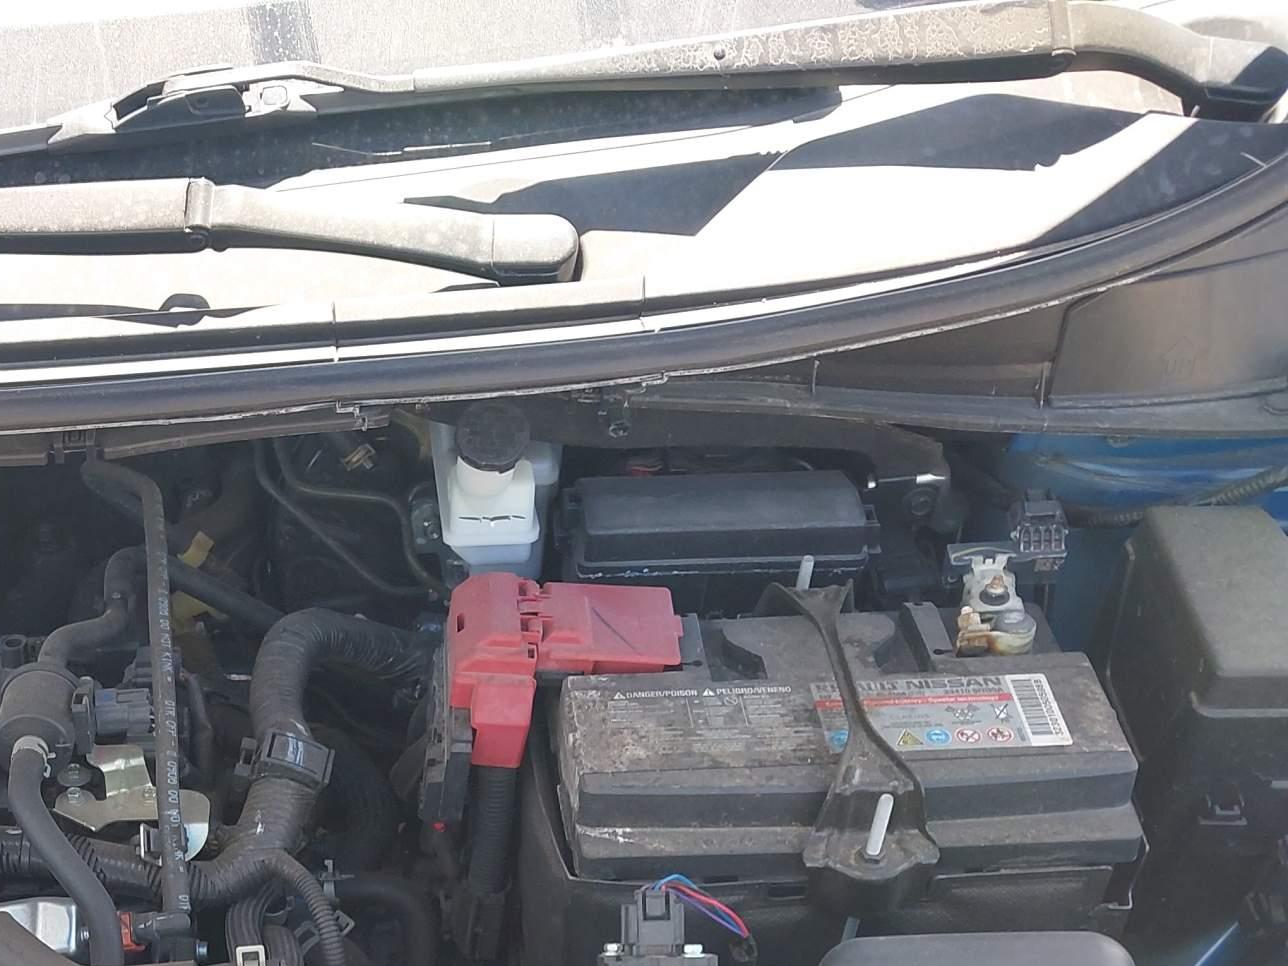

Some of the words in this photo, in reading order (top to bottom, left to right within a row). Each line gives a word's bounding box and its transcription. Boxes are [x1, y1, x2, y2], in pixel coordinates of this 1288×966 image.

[905, 677, 1002, 689] NISSAN
[626, 689, 698, 699] DANGER/POISON
[716, 686, 791, 695] PELIGRO/VENENO
